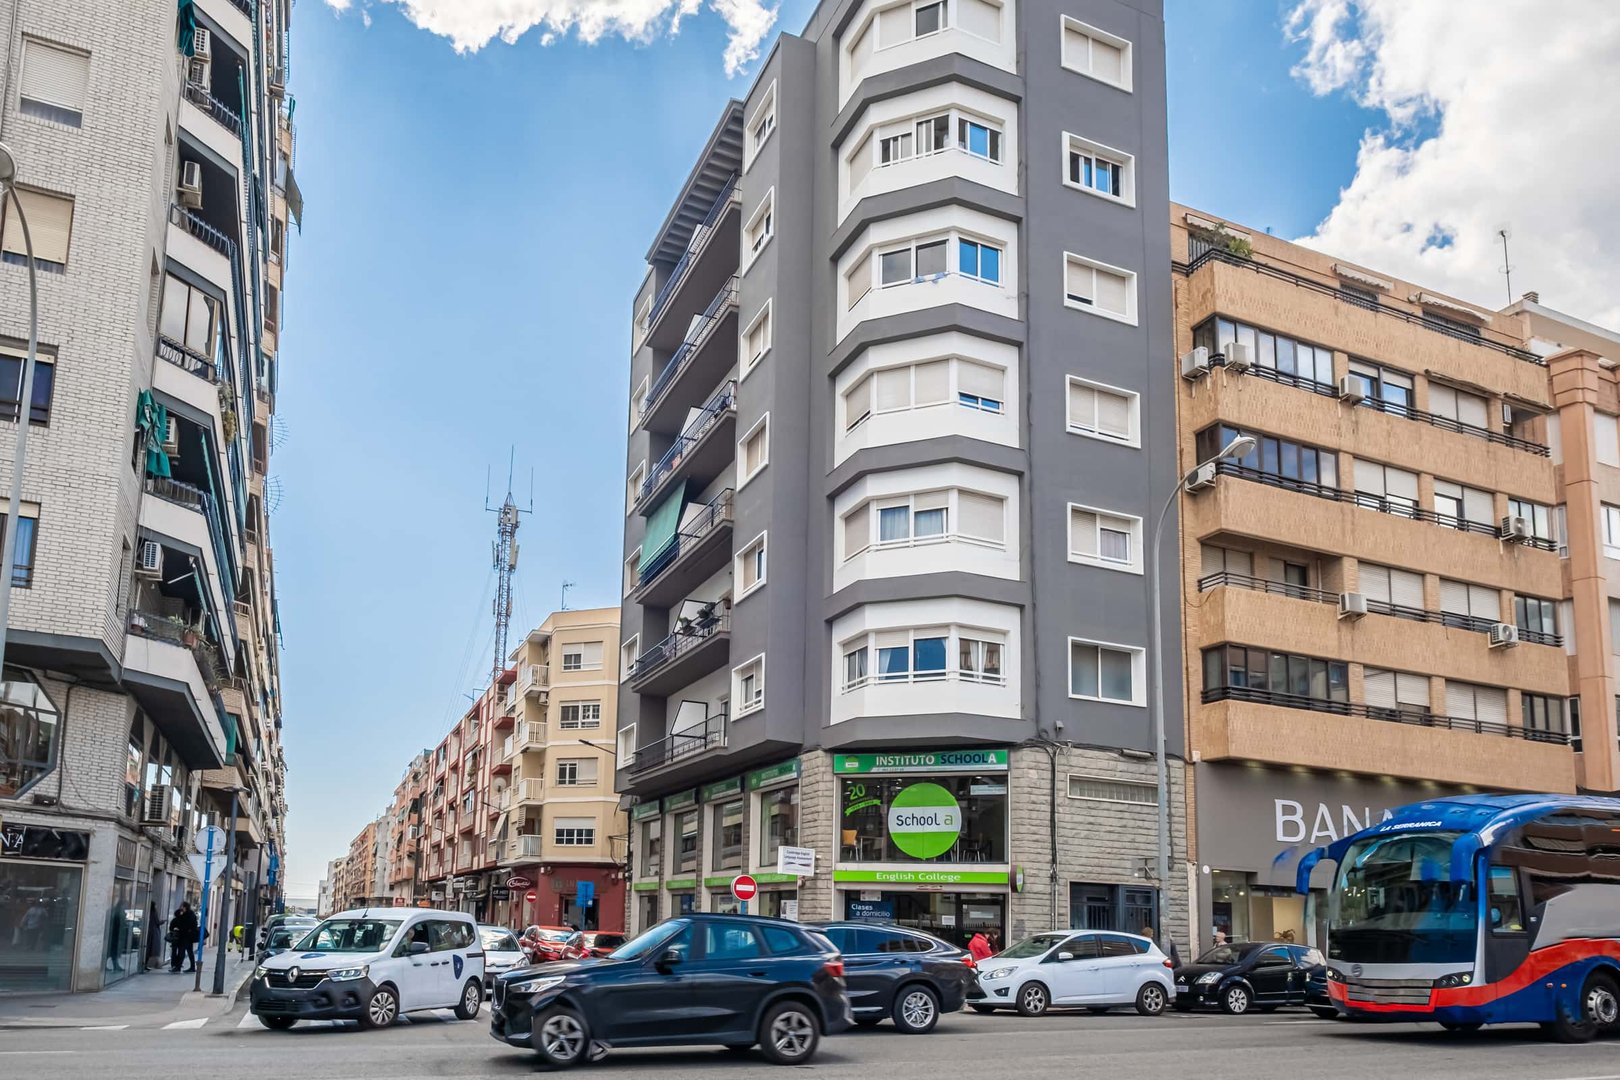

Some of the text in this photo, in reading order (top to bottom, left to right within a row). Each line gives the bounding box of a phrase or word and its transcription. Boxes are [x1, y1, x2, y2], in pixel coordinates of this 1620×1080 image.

[876, 753, 997, 766] INSTITUTO SCHOOLA
[848, 783, 866, 800] 20
[896, 813, 953, 827] School a
[1274, 799, 1394, 844] BAN
[1391, 821, 1442, 830] SERRANICA
[876, 872, 961, 882] English College
[851, 903, 873, 911] Clases
